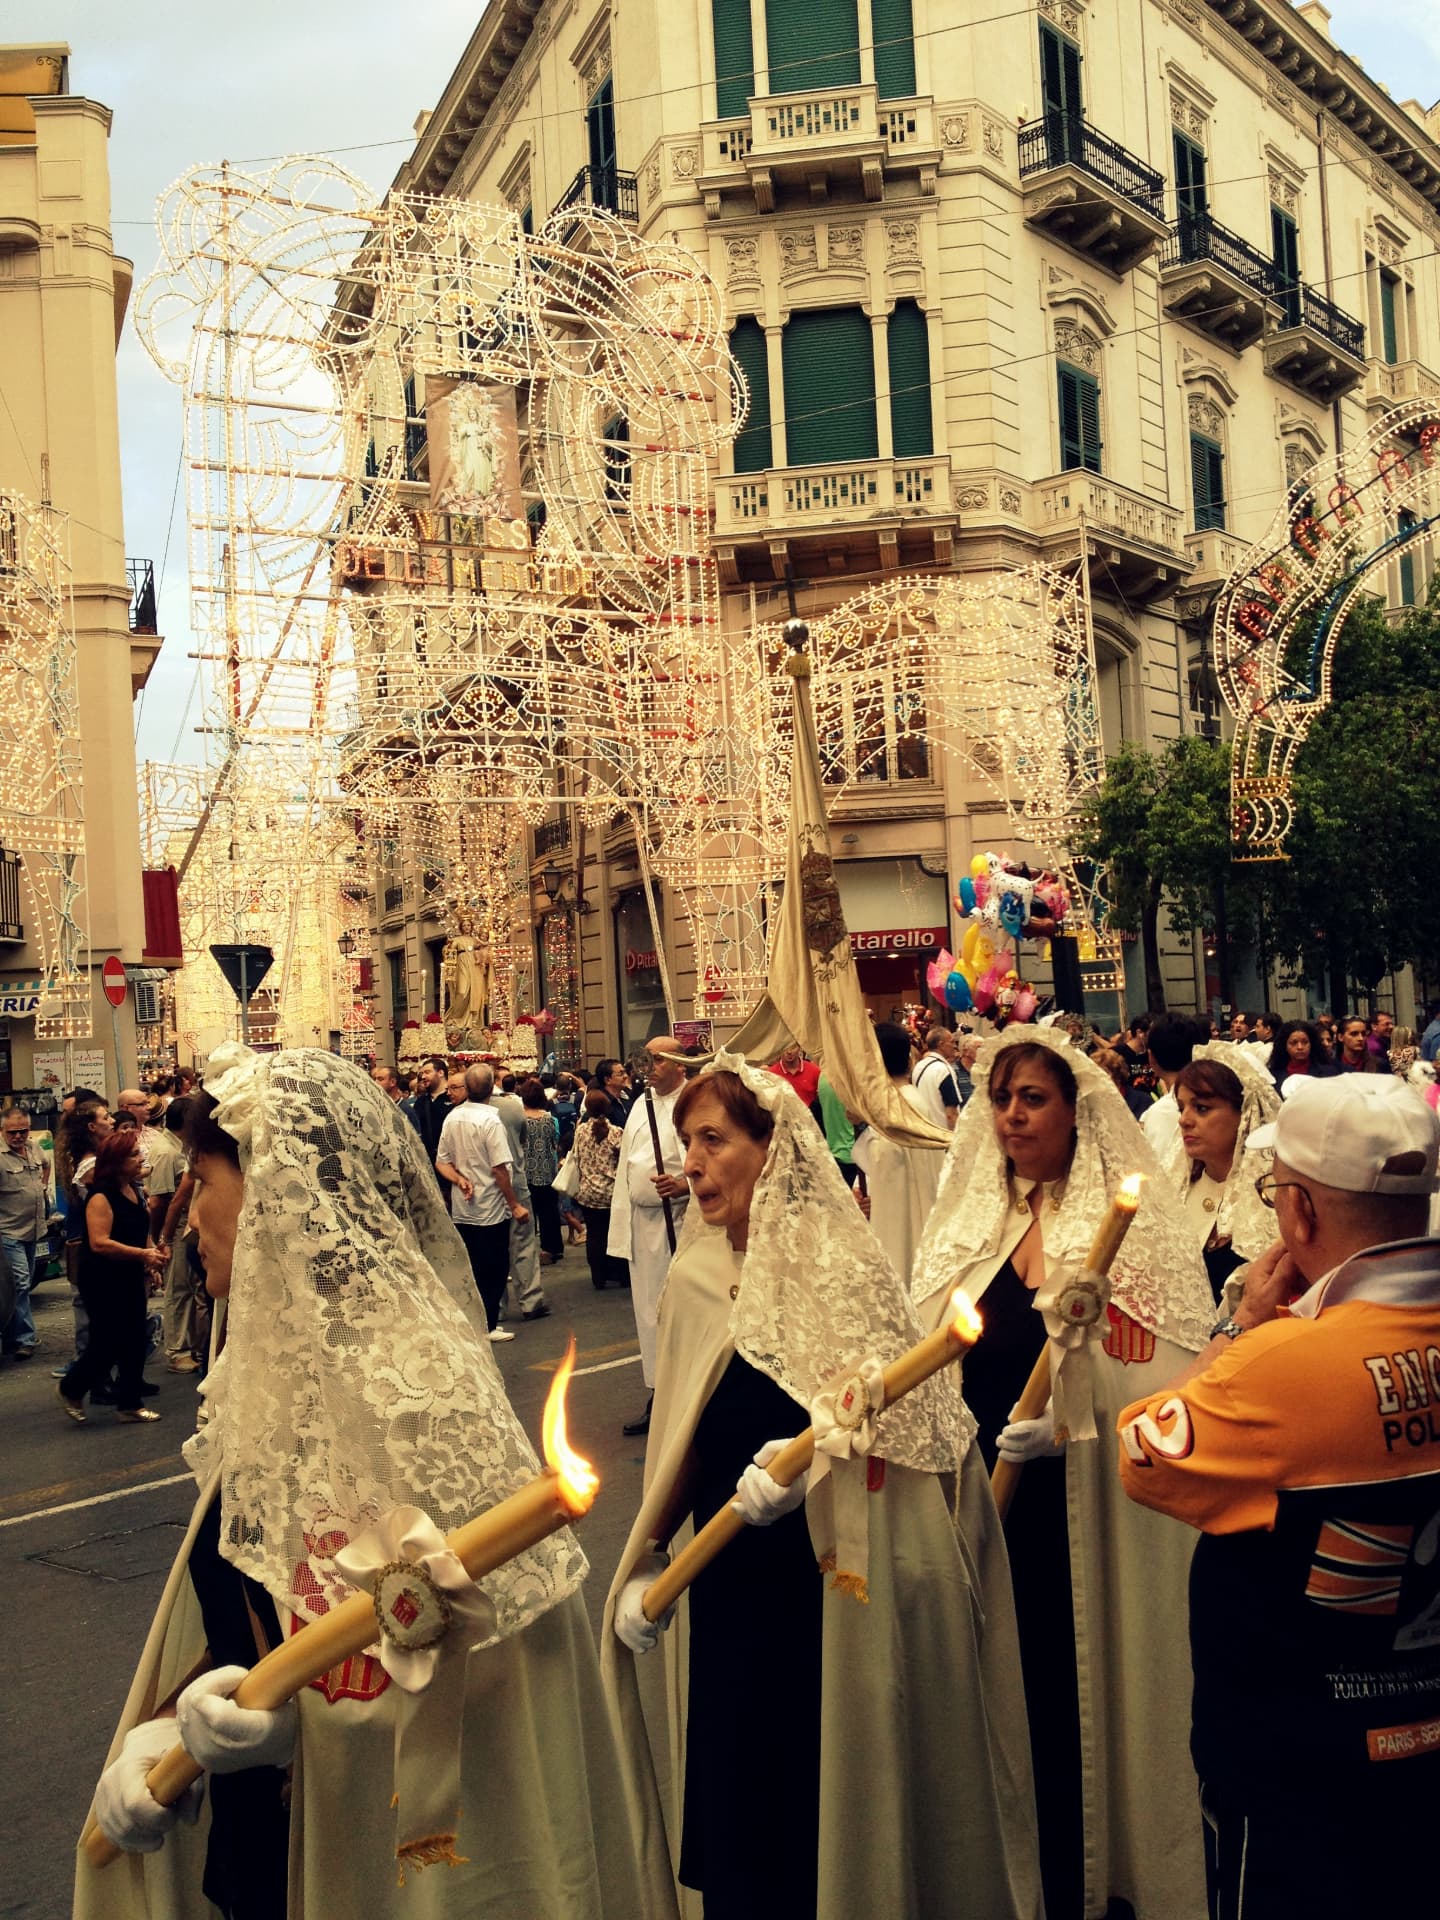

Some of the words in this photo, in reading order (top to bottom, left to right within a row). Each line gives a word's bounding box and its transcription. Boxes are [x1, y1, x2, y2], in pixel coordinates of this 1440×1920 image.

[341, 540, 447, 585] DELLA
[454, 556, 600, 598] MERCEDE
[0, 996, 40, 1012] RIA
